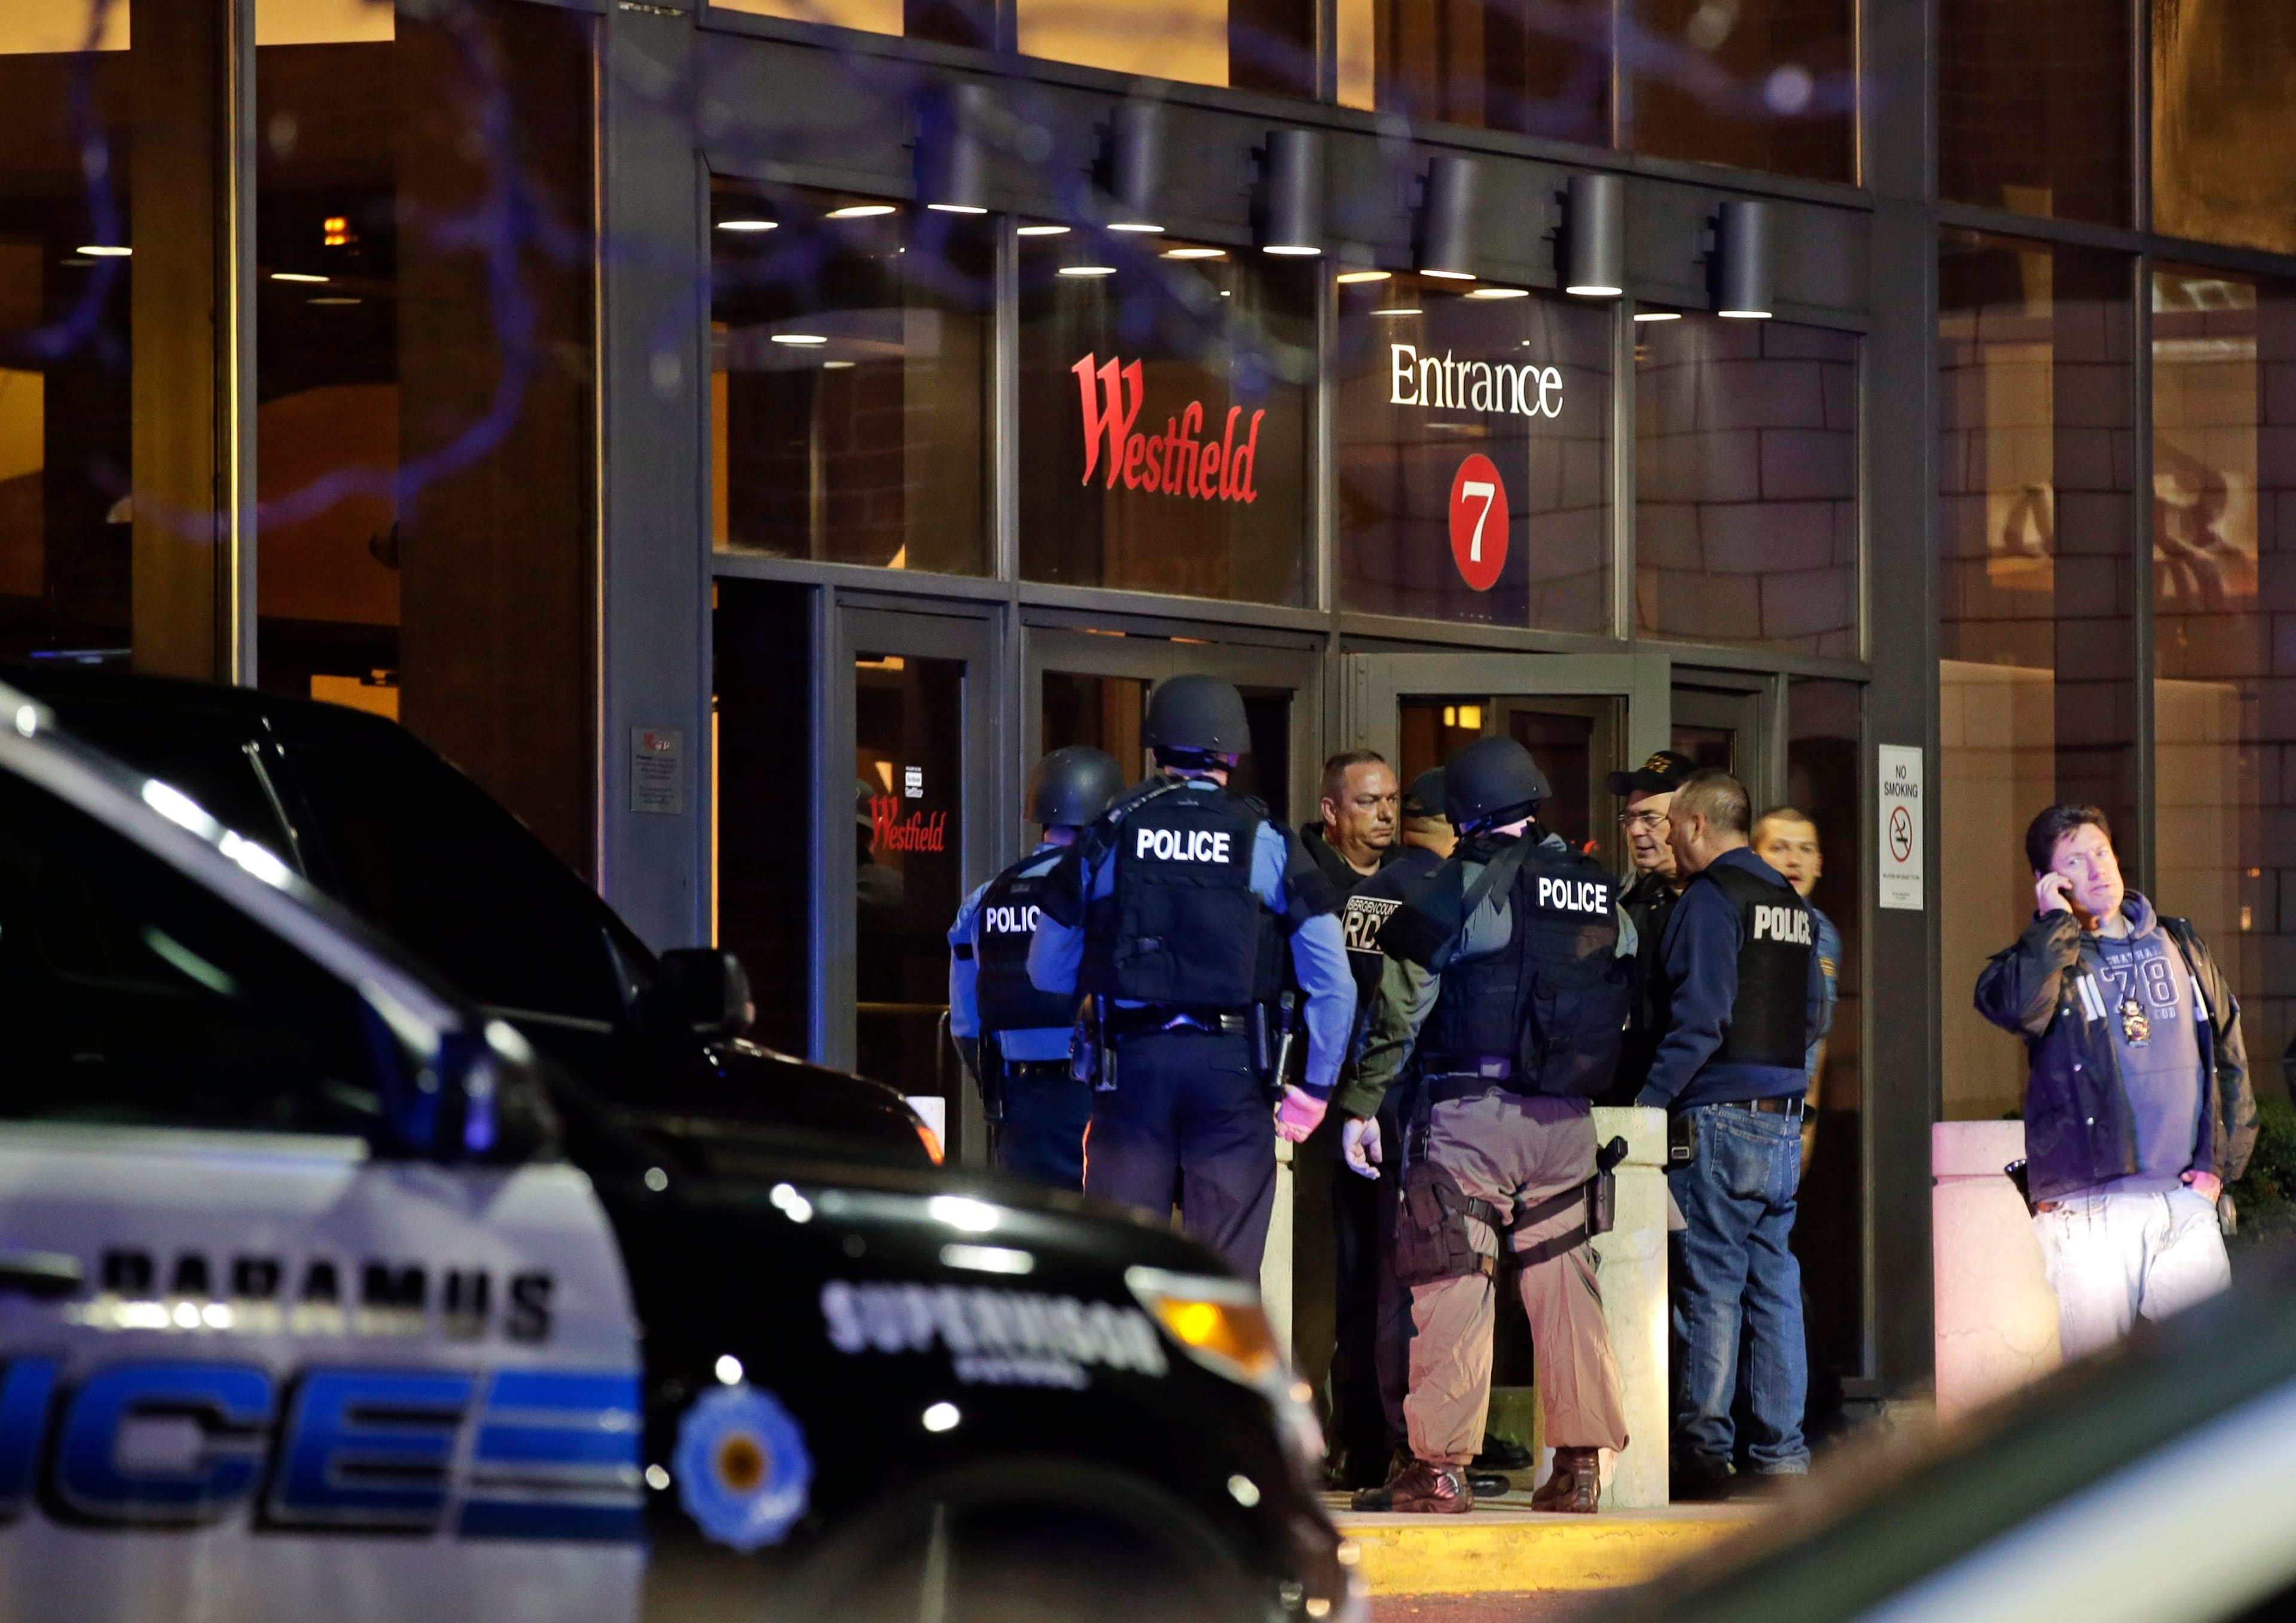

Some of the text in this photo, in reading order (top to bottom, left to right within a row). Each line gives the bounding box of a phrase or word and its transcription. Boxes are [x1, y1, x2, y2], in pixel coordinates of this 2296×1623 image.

[1390, 343, 1563, 418] Entrance
[1071, 352, 1265, 504] Westfield
[1461, 481, 1495, 563] 7
[1884, 782, 1918, 798] SMOKING
[1896, 765, 1907, 779] NO
[868, 794, 947, 852] Westfield
[1137, 828, 1231, 863] POLICE
[1348, 899, 1399, 916] BERGEN COUN
[1539, 877, 1608, 914] POLICE
[987, 905, 1040, 933] POLIC
[1344, 911, 1390, 950] RD
[2099, 956, 2179, 1014] 78
